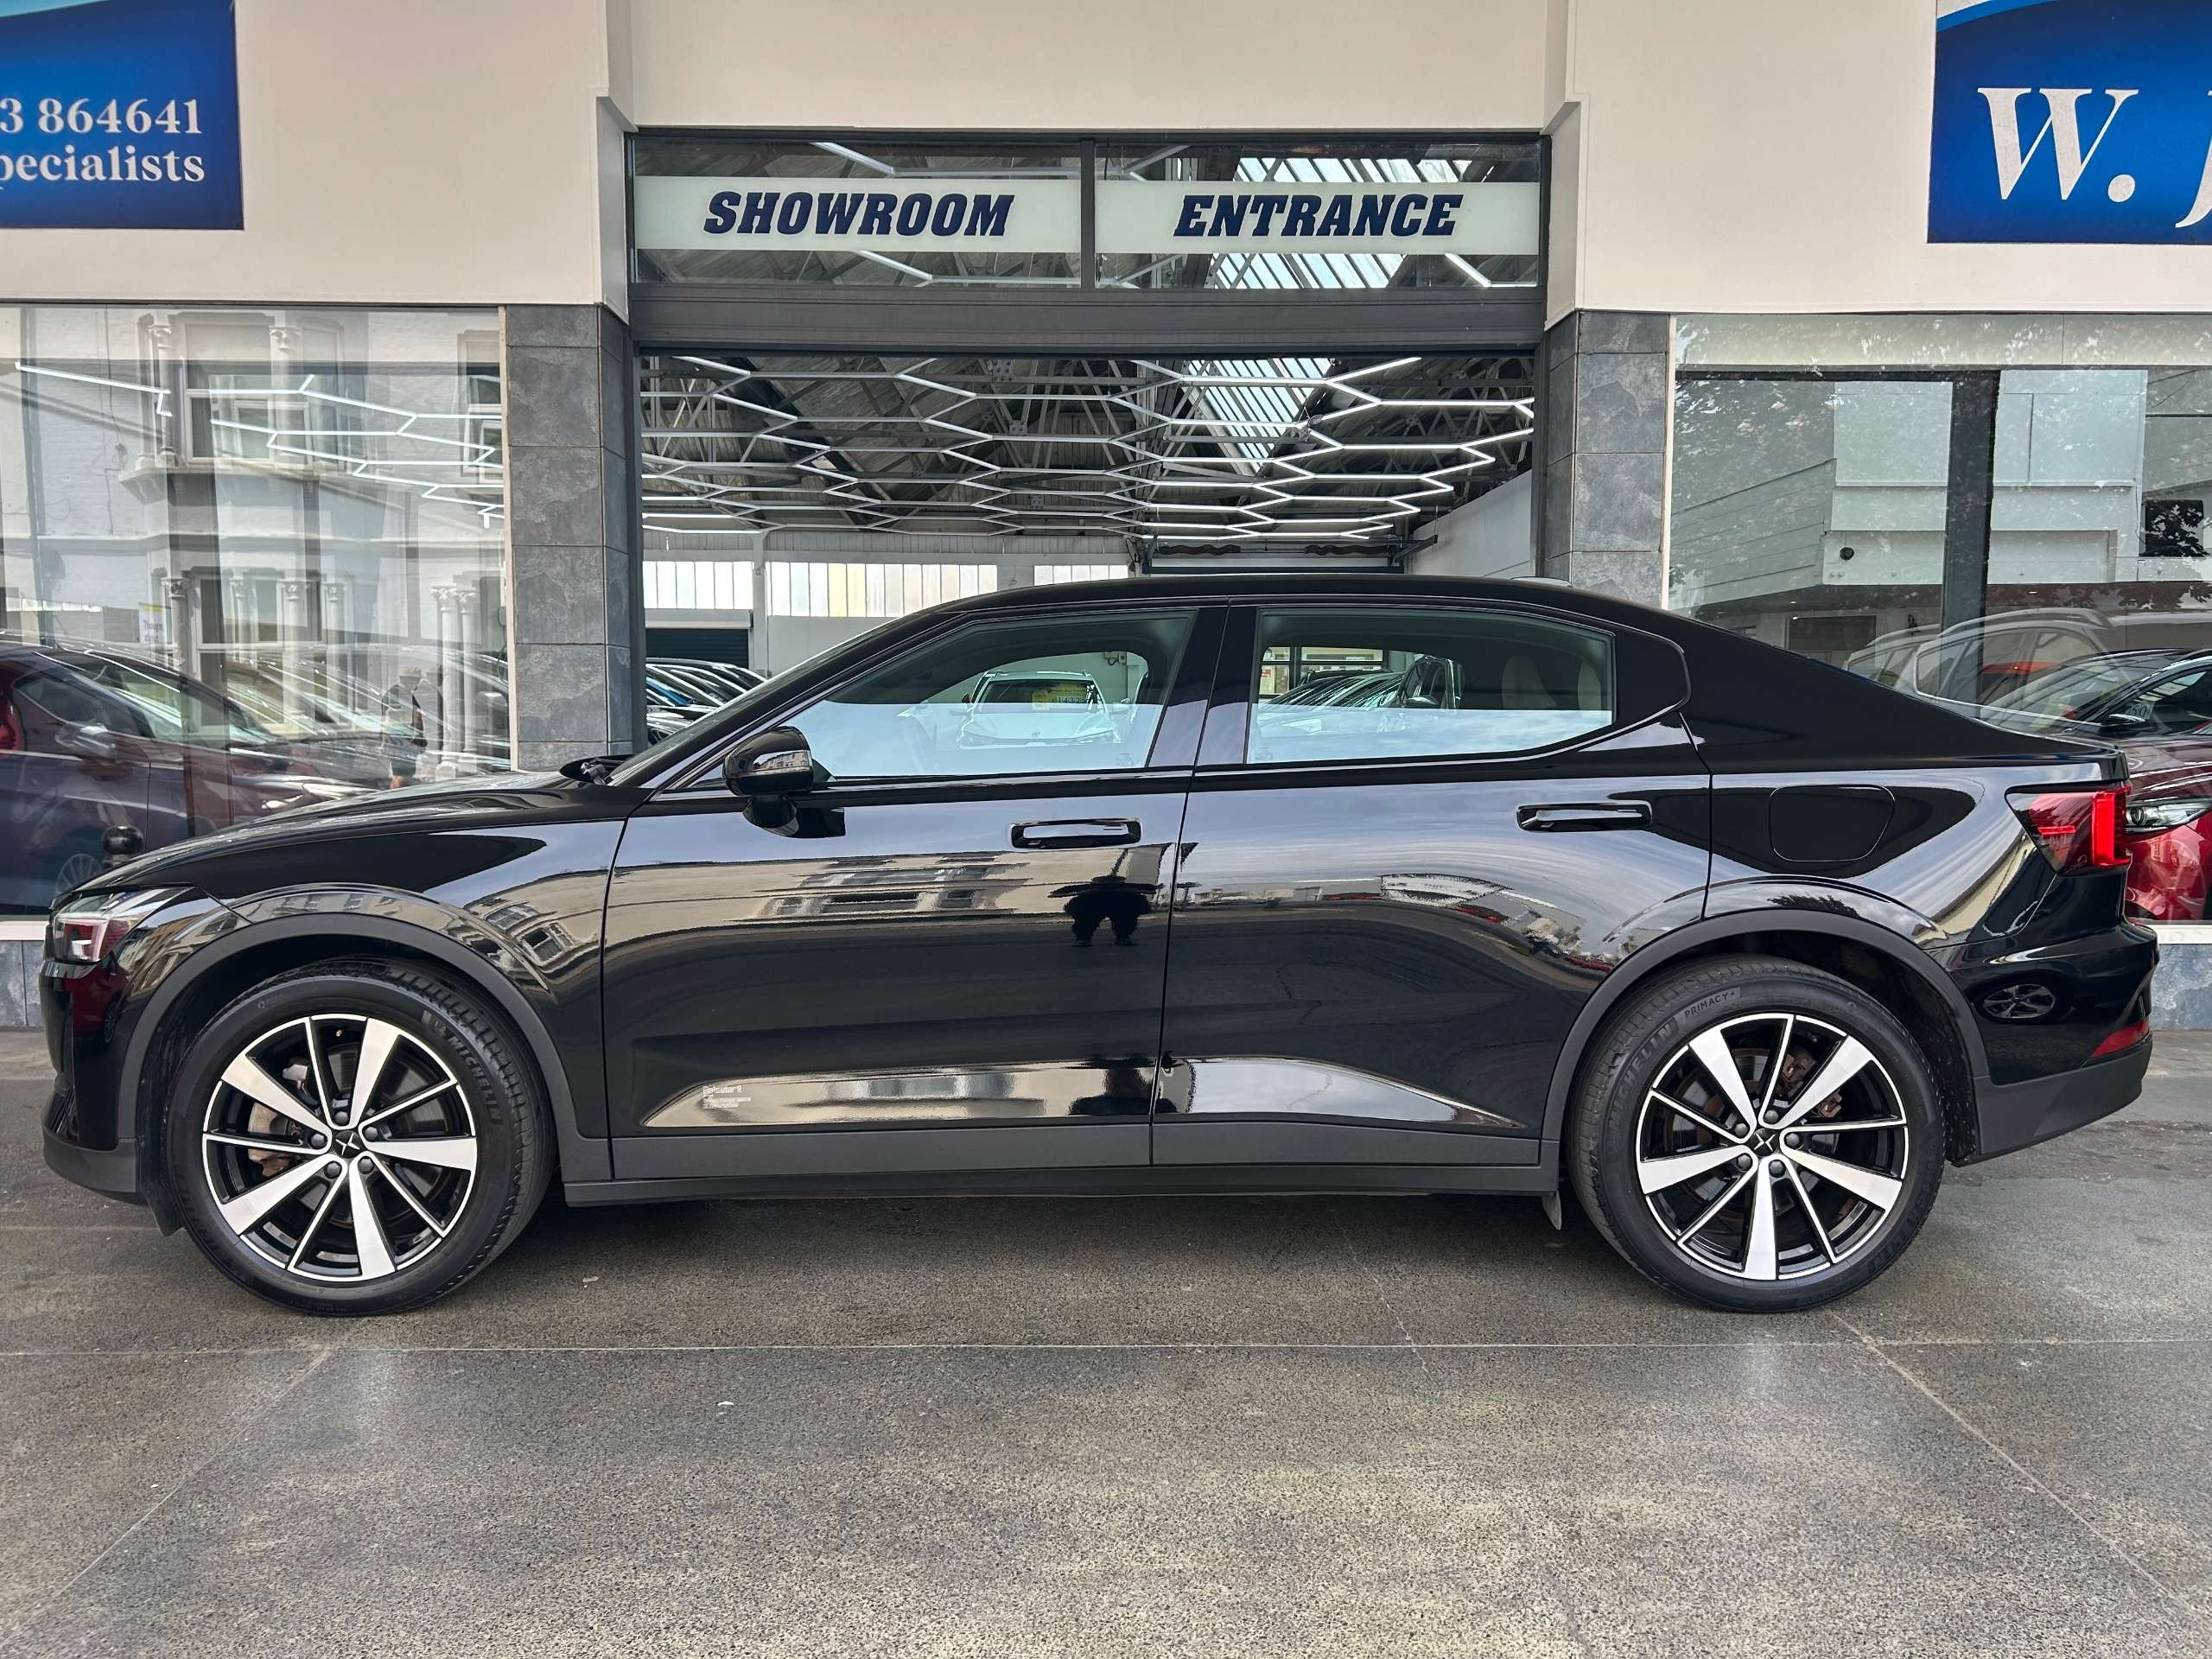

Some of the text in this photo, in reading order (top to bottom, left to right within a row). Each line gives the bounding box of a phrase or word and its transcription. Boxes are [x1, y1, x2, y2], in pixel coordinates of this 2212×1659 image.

[38, 98, 203, 135] 864641
[1977, 87, 2139, 203] W.
[702, 190, 1015, 237] SHOWROOM
[1173, 194, 1465, 238] ENTRANCE
[1684, 992, 1728, 1018] PRIMACY
[446, 1036, 502, 1121] MICHELIN
[1608, 1023, 1675, 1127] MICHELIN
